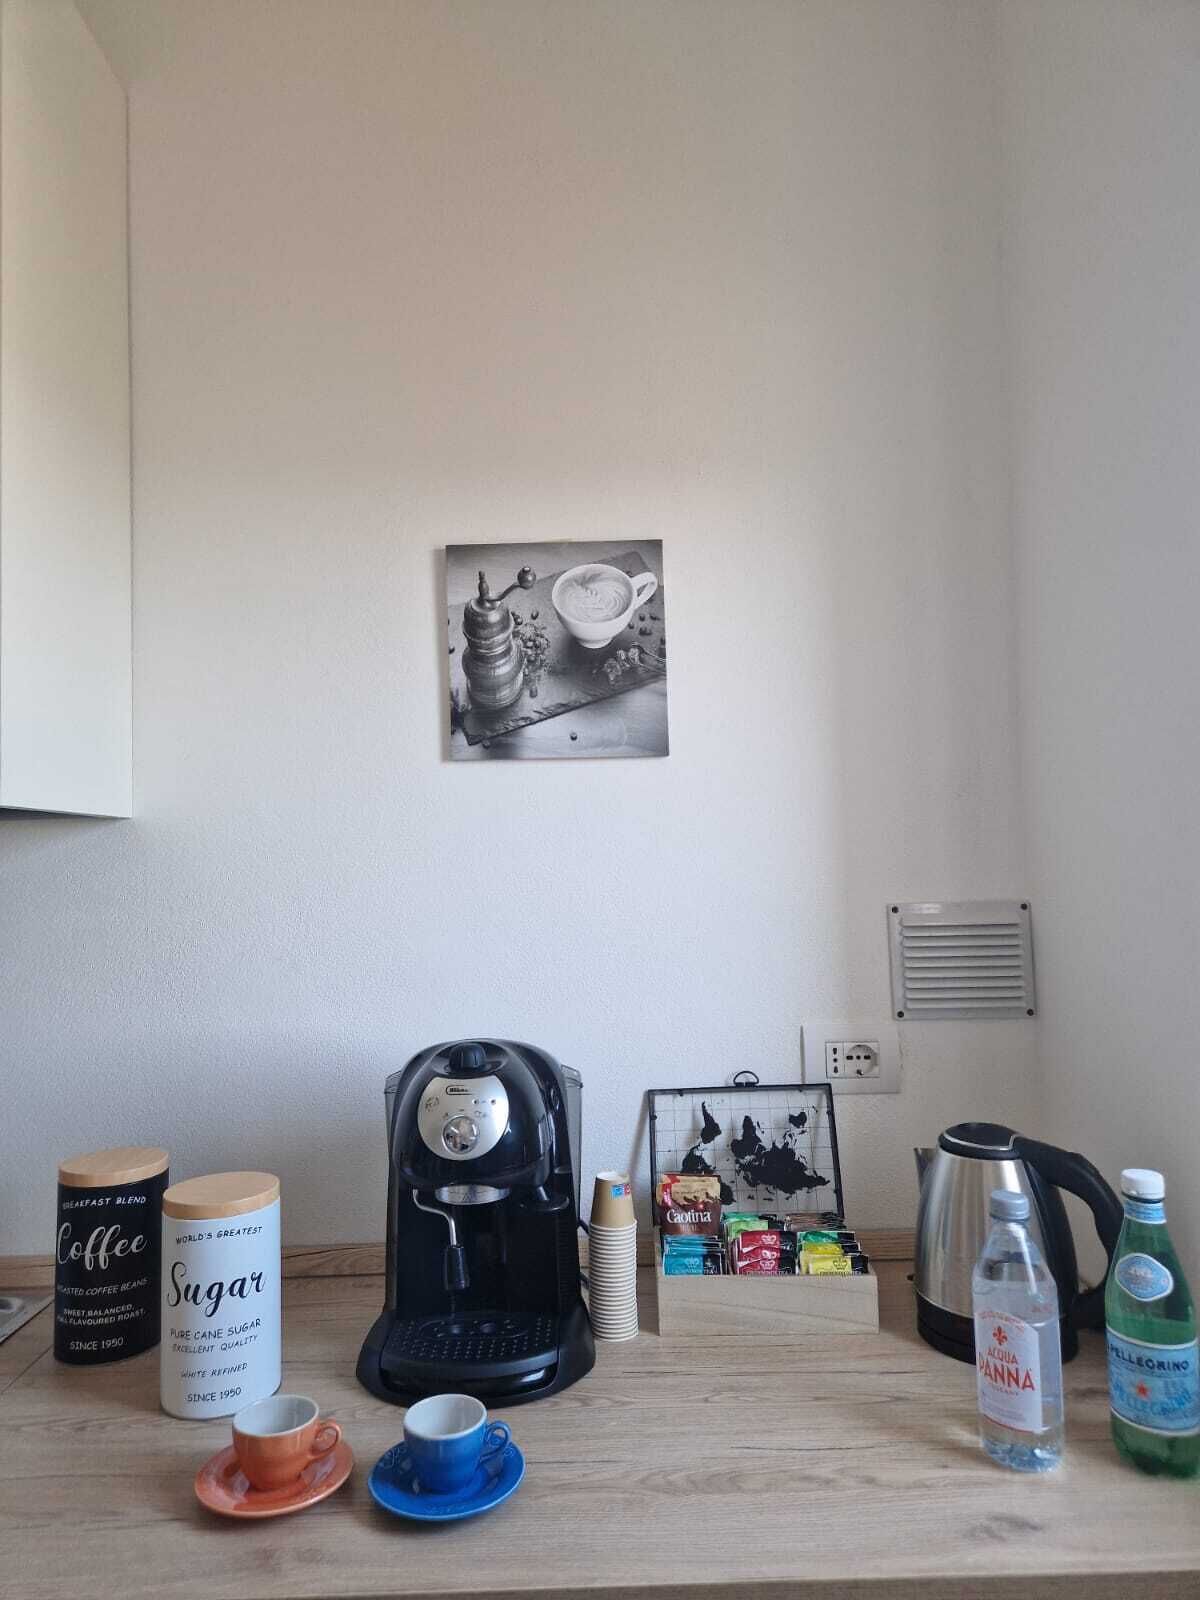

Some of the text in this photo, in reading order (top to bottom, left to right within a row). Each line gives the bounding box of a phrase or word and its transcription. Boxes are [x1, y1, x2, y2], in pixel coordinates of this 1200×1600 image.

[116, 1196, 147, 1205] BLEND
[667, 1208, 712, 1224] Caotina
[176, 1226, 263, 1244] WORLD'S GREATEST
[57, 1222, 147, 1271] Coffee
[85, 1286, 119, 1297] COFFEE
[167, 1261, 266, 1318] Sugar
[170, 1318, 261, 1340] PURE CANE SUGAR
[70, 1340, 98, 1351] SINCE
[172, 1334, 258, 1354] EXCELLENT QUALITY
[987, 1347, 1018, 1365] ACQUA
[181, 1362, 248, 1379] WHITE REFINED
[977, 1352, 1036, 1391] PANNA
[187, 1387, 242, 1403] SINCE 1950
